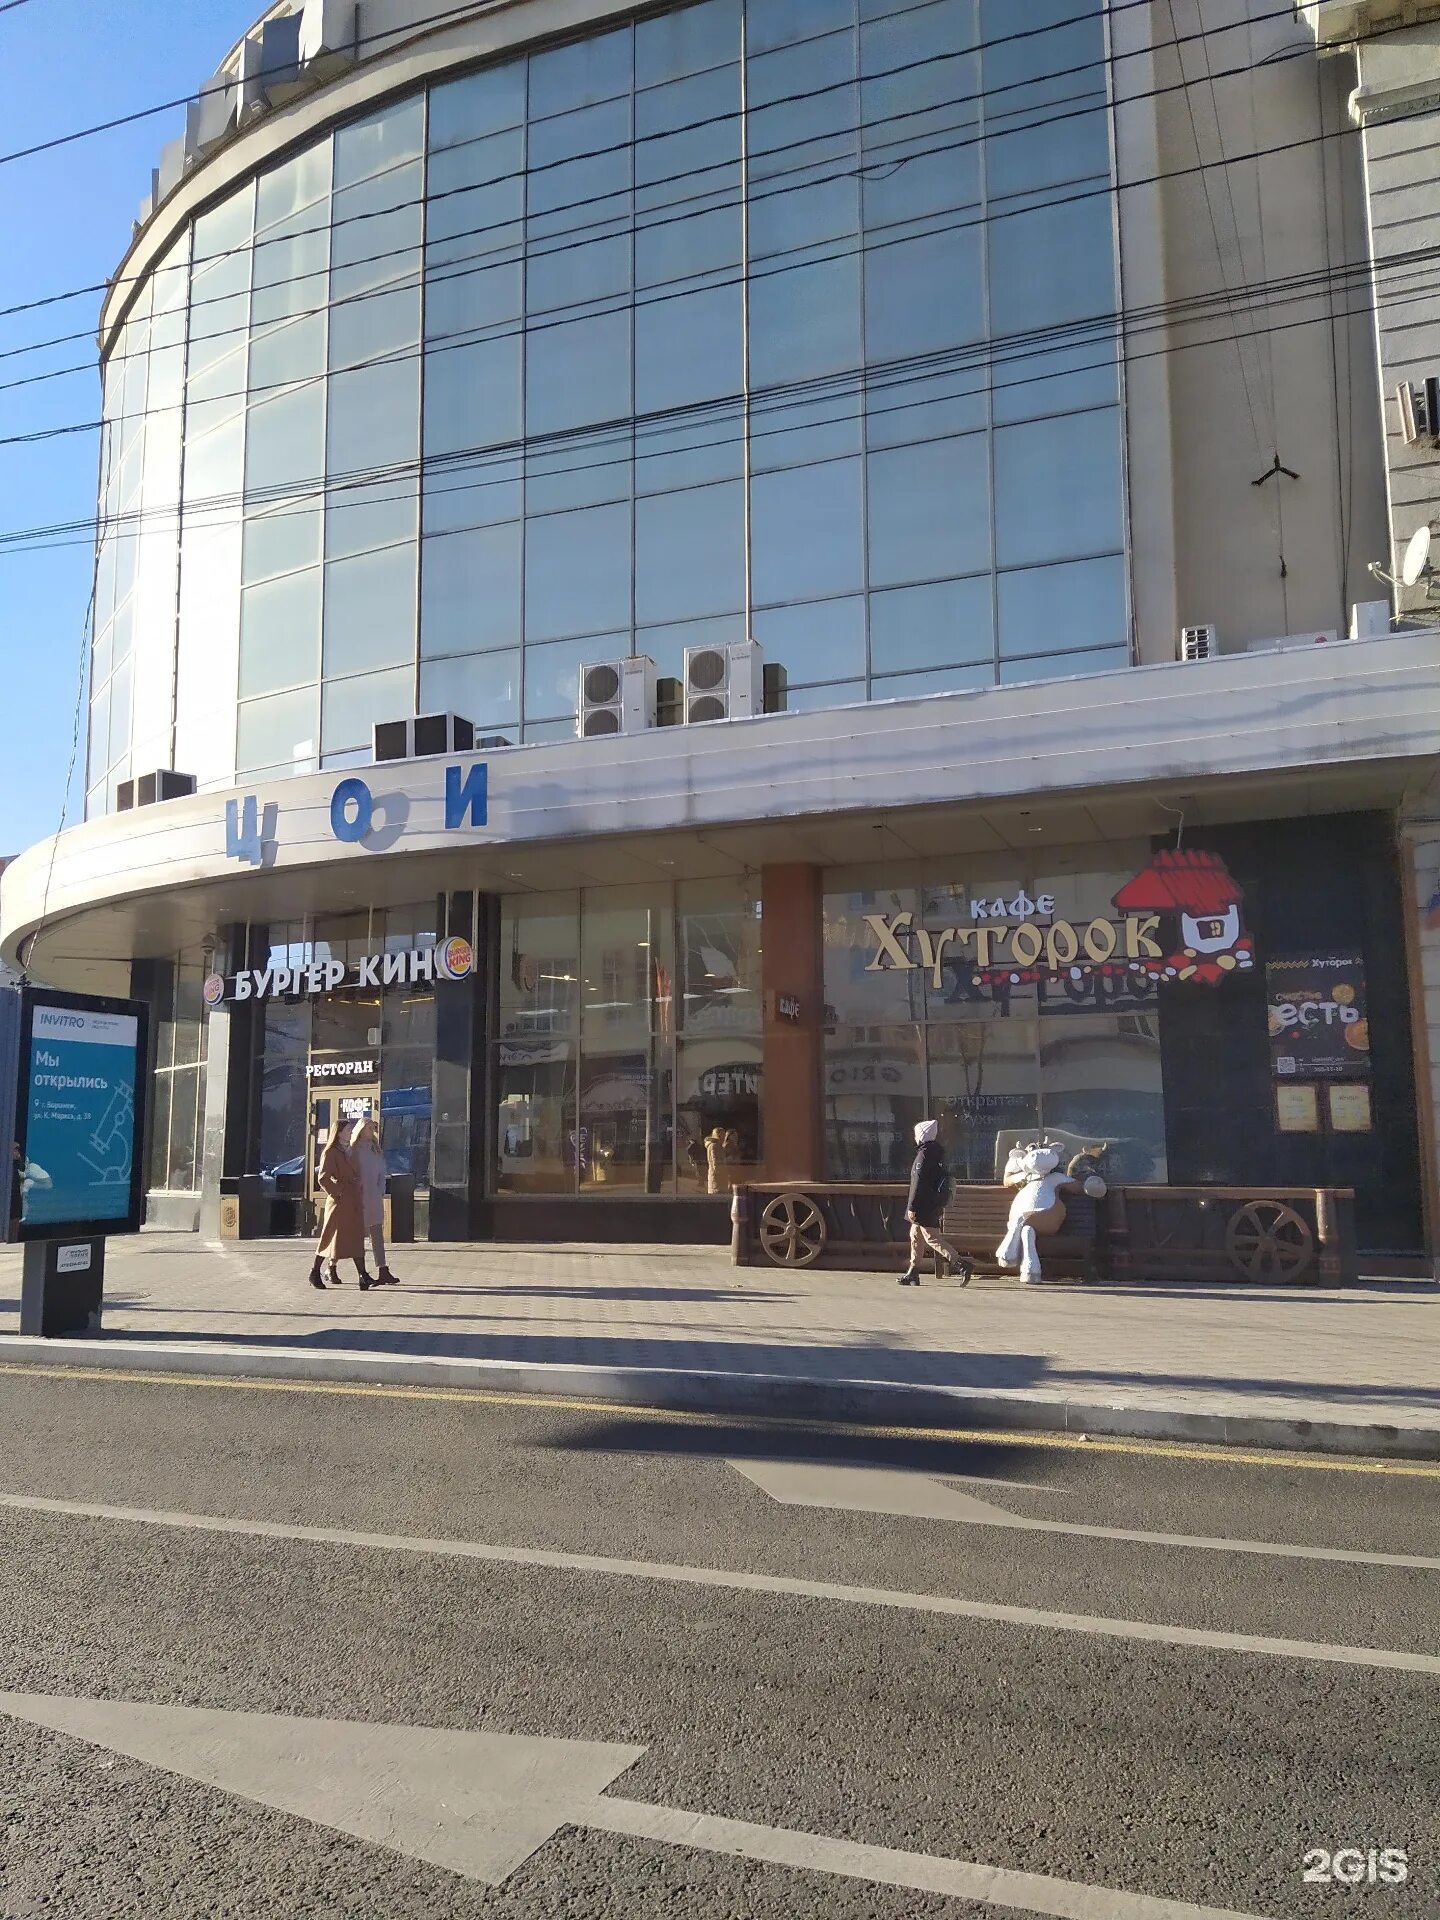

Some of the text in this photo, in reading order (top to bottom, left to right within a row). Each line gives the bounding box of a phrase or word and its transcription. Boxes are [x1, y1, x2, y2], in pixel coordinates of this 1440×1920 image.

[970, 889, 1056, 922] кафе
[862, 911, 1164, 989] Хуторок
[448, 952, 472, 968] KING
[235, 948, 445, 1001] БУРГЕР КИН
[40, 1013, 85, 1029] INVITRO
[35, 1050, 60, 1067] Мы
[305, 1060, 374, 1078] РЕСТОРАН
[34, 1074, 108, 1091] открылись
